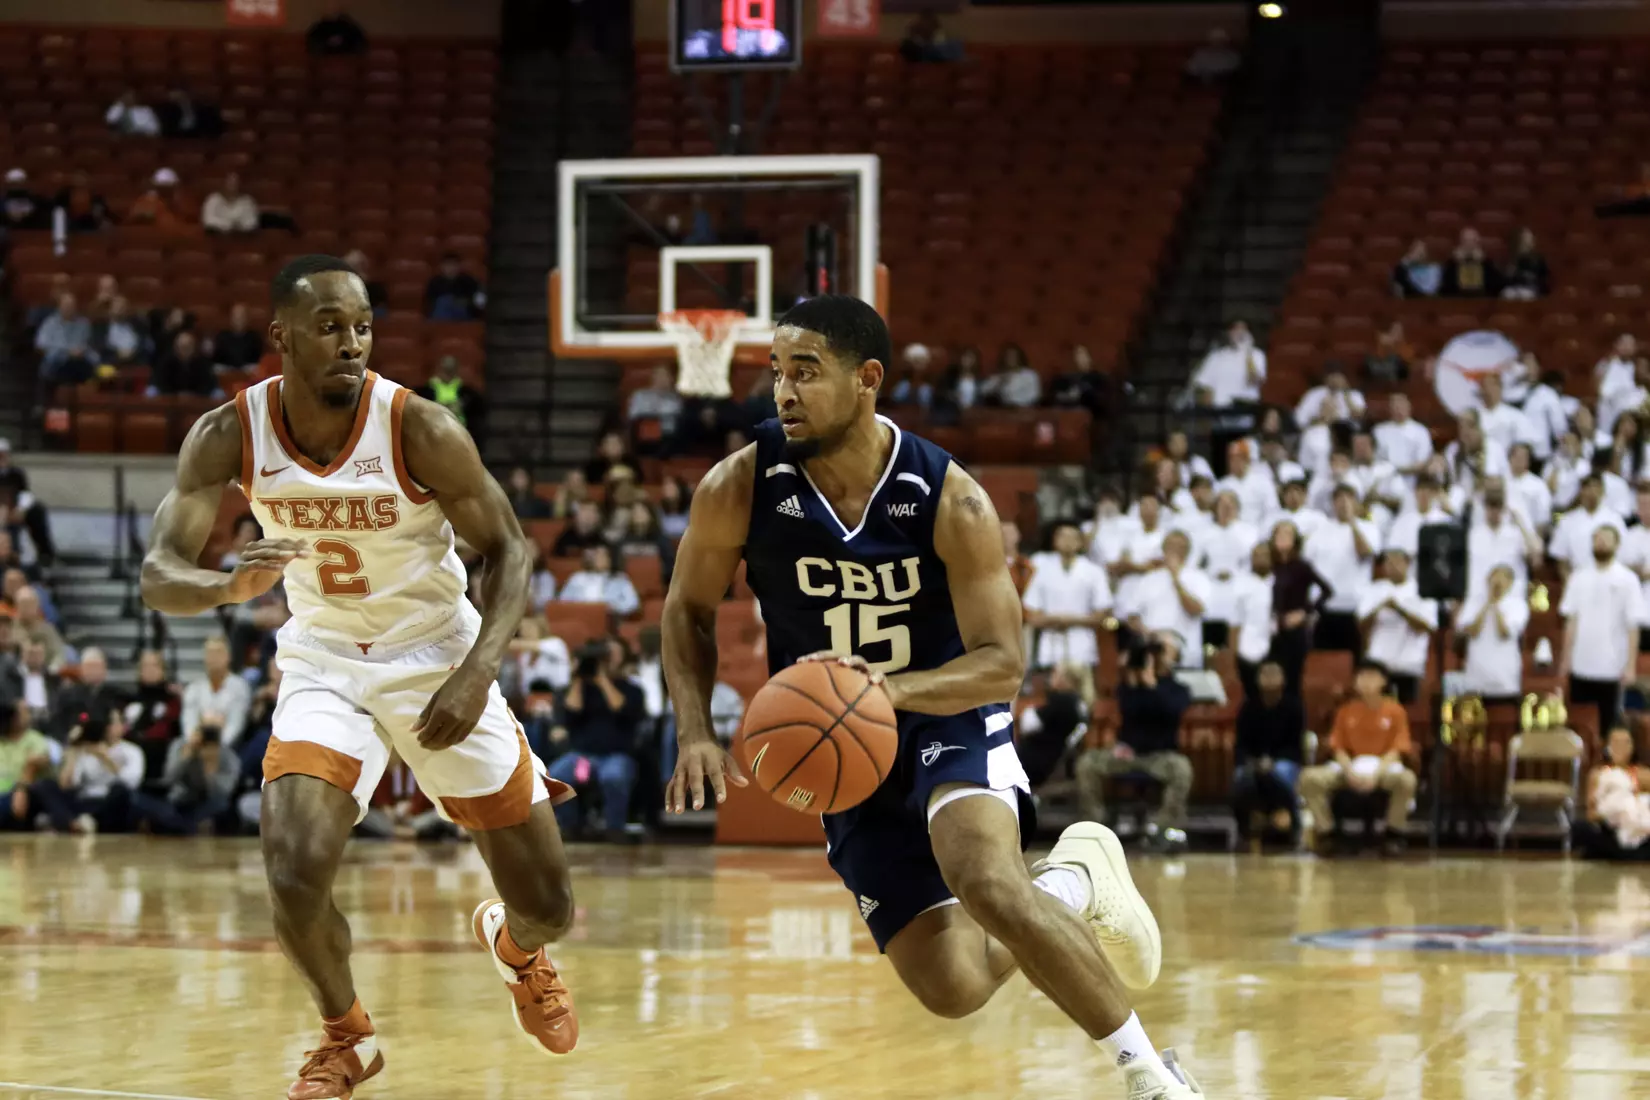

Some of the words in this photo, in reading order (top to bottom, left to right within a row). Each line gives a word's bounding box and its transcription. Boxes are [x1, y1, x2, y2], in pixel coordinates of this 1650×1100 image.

[256, 494, 400, 531] TEXAS
[776, 504, 804, 519] adidas
[887, 502, 918, 517] WAC
[313, 538, 371, 596] 2
[795, 556, 921, 602] CBU
[823, 603, 911, 675] 15
